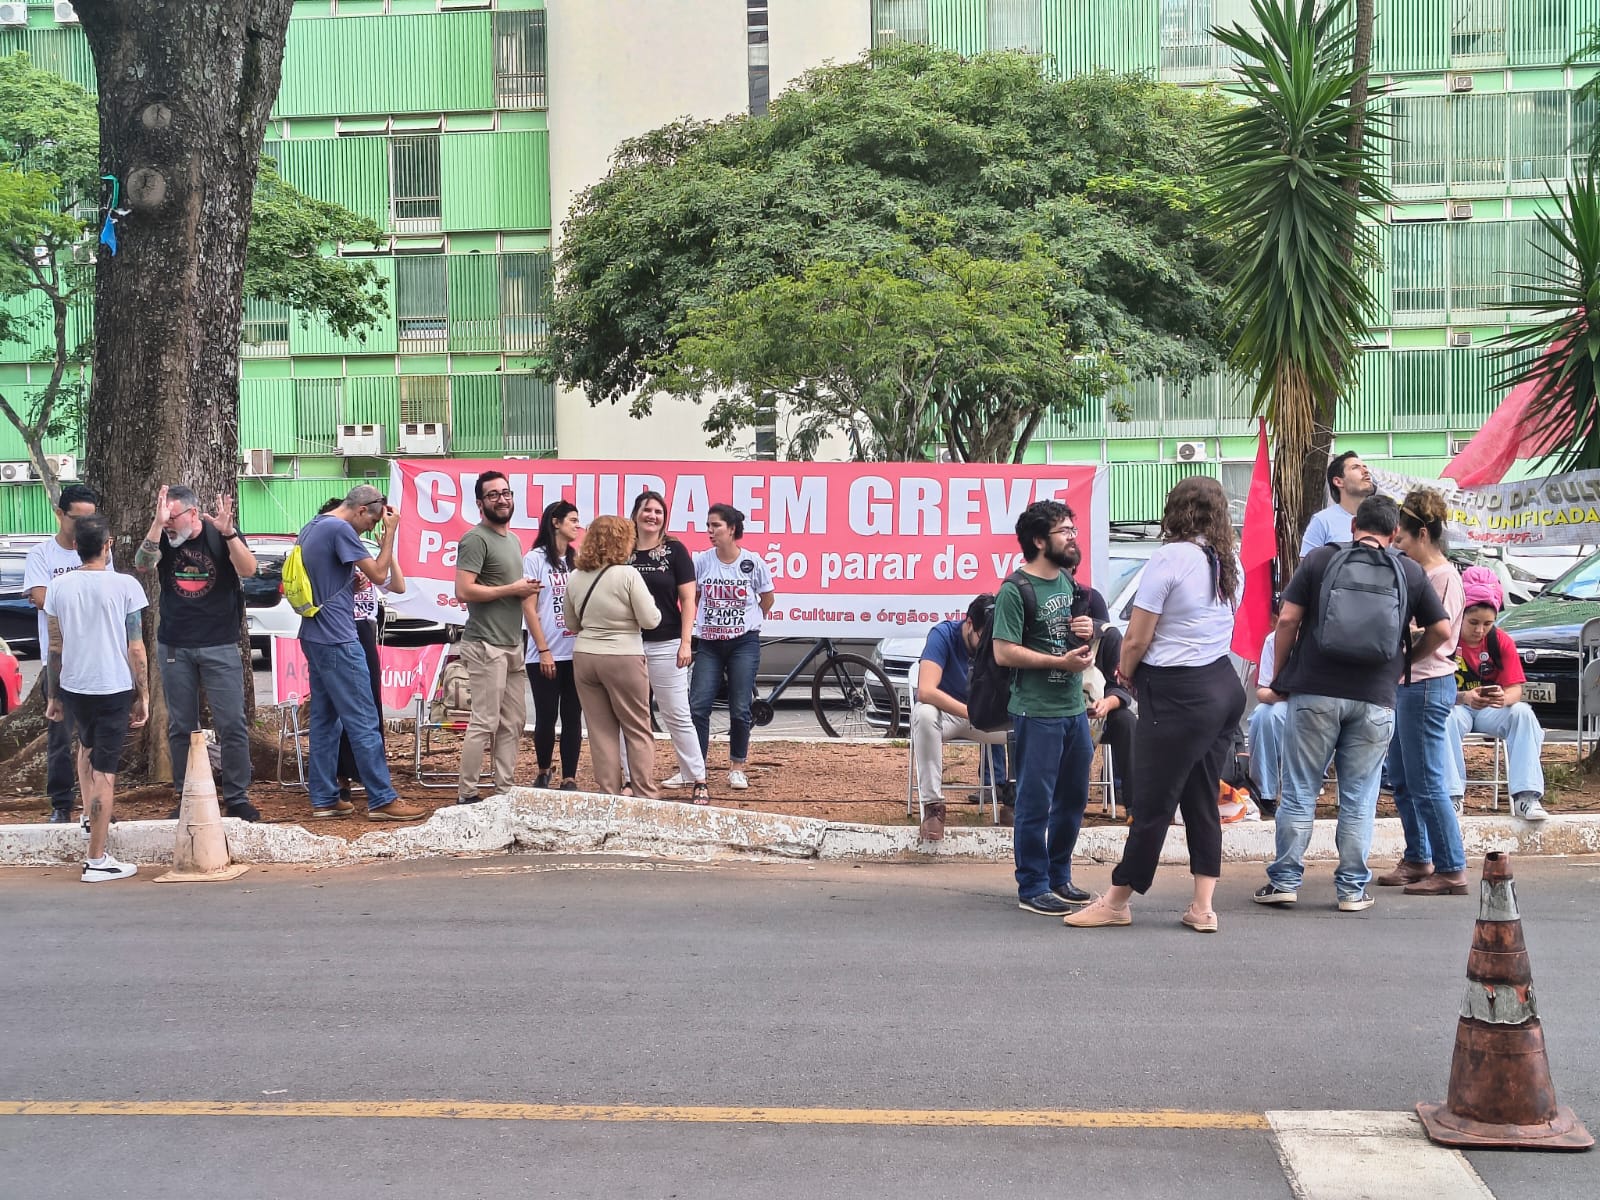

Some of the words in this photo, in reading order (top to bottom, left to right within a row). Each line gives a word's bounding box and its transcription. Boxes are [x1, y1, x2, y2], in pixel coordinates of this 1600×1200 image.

[732, 475, 828, 534] EM
[1487, 506, 1600, 530] UNIFICADA
[820, 551, 922, 589] parar
[932, 544, 979, 580] de
[715, 609, 746, 618] ANOS
[717, 617, 746, 626] LUTA
[789, 607, 855, 622] Cultura
[860, 611, 872, 622] e
[876, 607, 939, 626] órgãos
